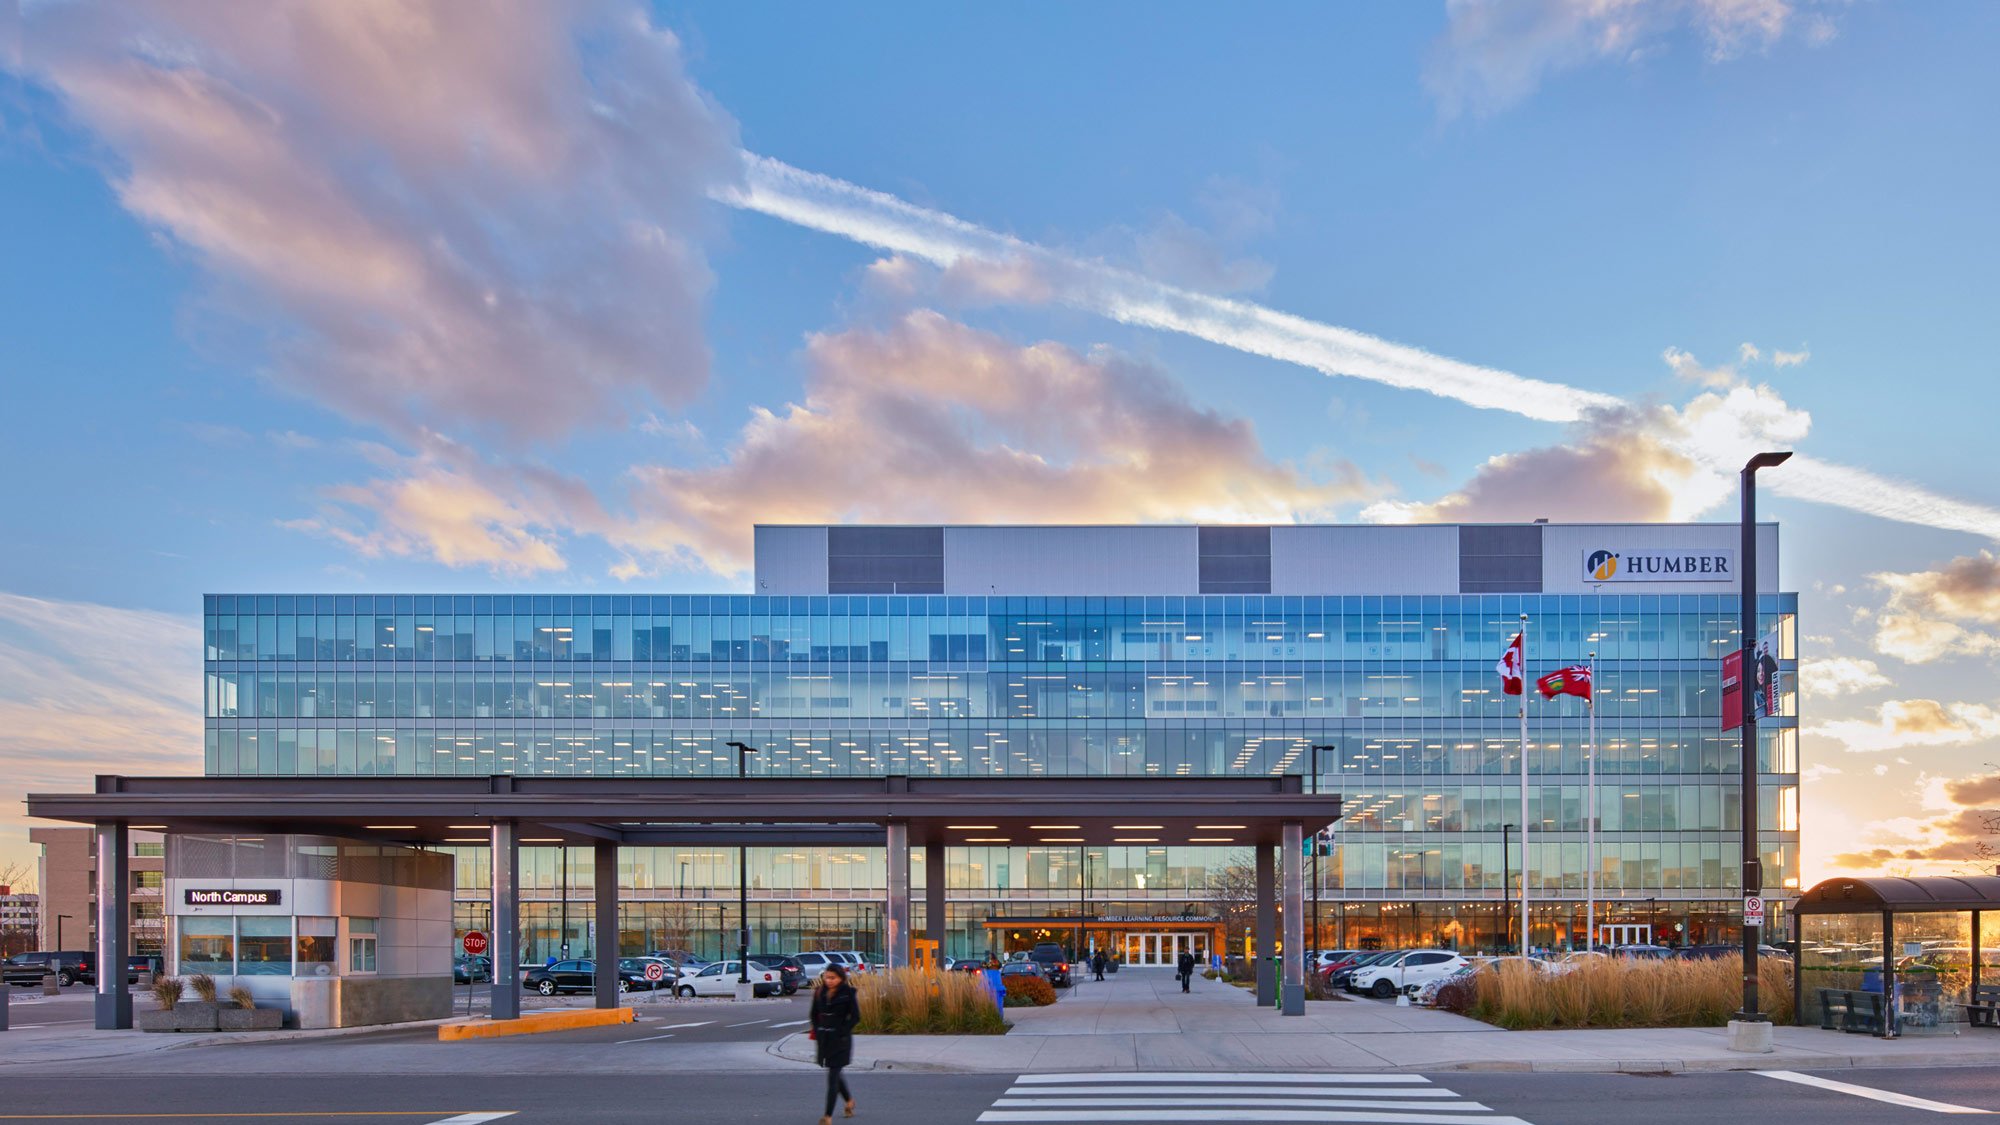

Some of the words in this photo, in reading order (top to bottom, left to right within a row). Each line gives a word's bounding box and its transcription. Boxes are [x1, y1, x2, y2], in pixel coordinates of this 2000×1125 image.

[1626, 556, 1729, 573] HUMBER
[191, 891, 221, 902] North
[223, 891, 267, 904] Campus
[464, 938, 486, 948] STOP
